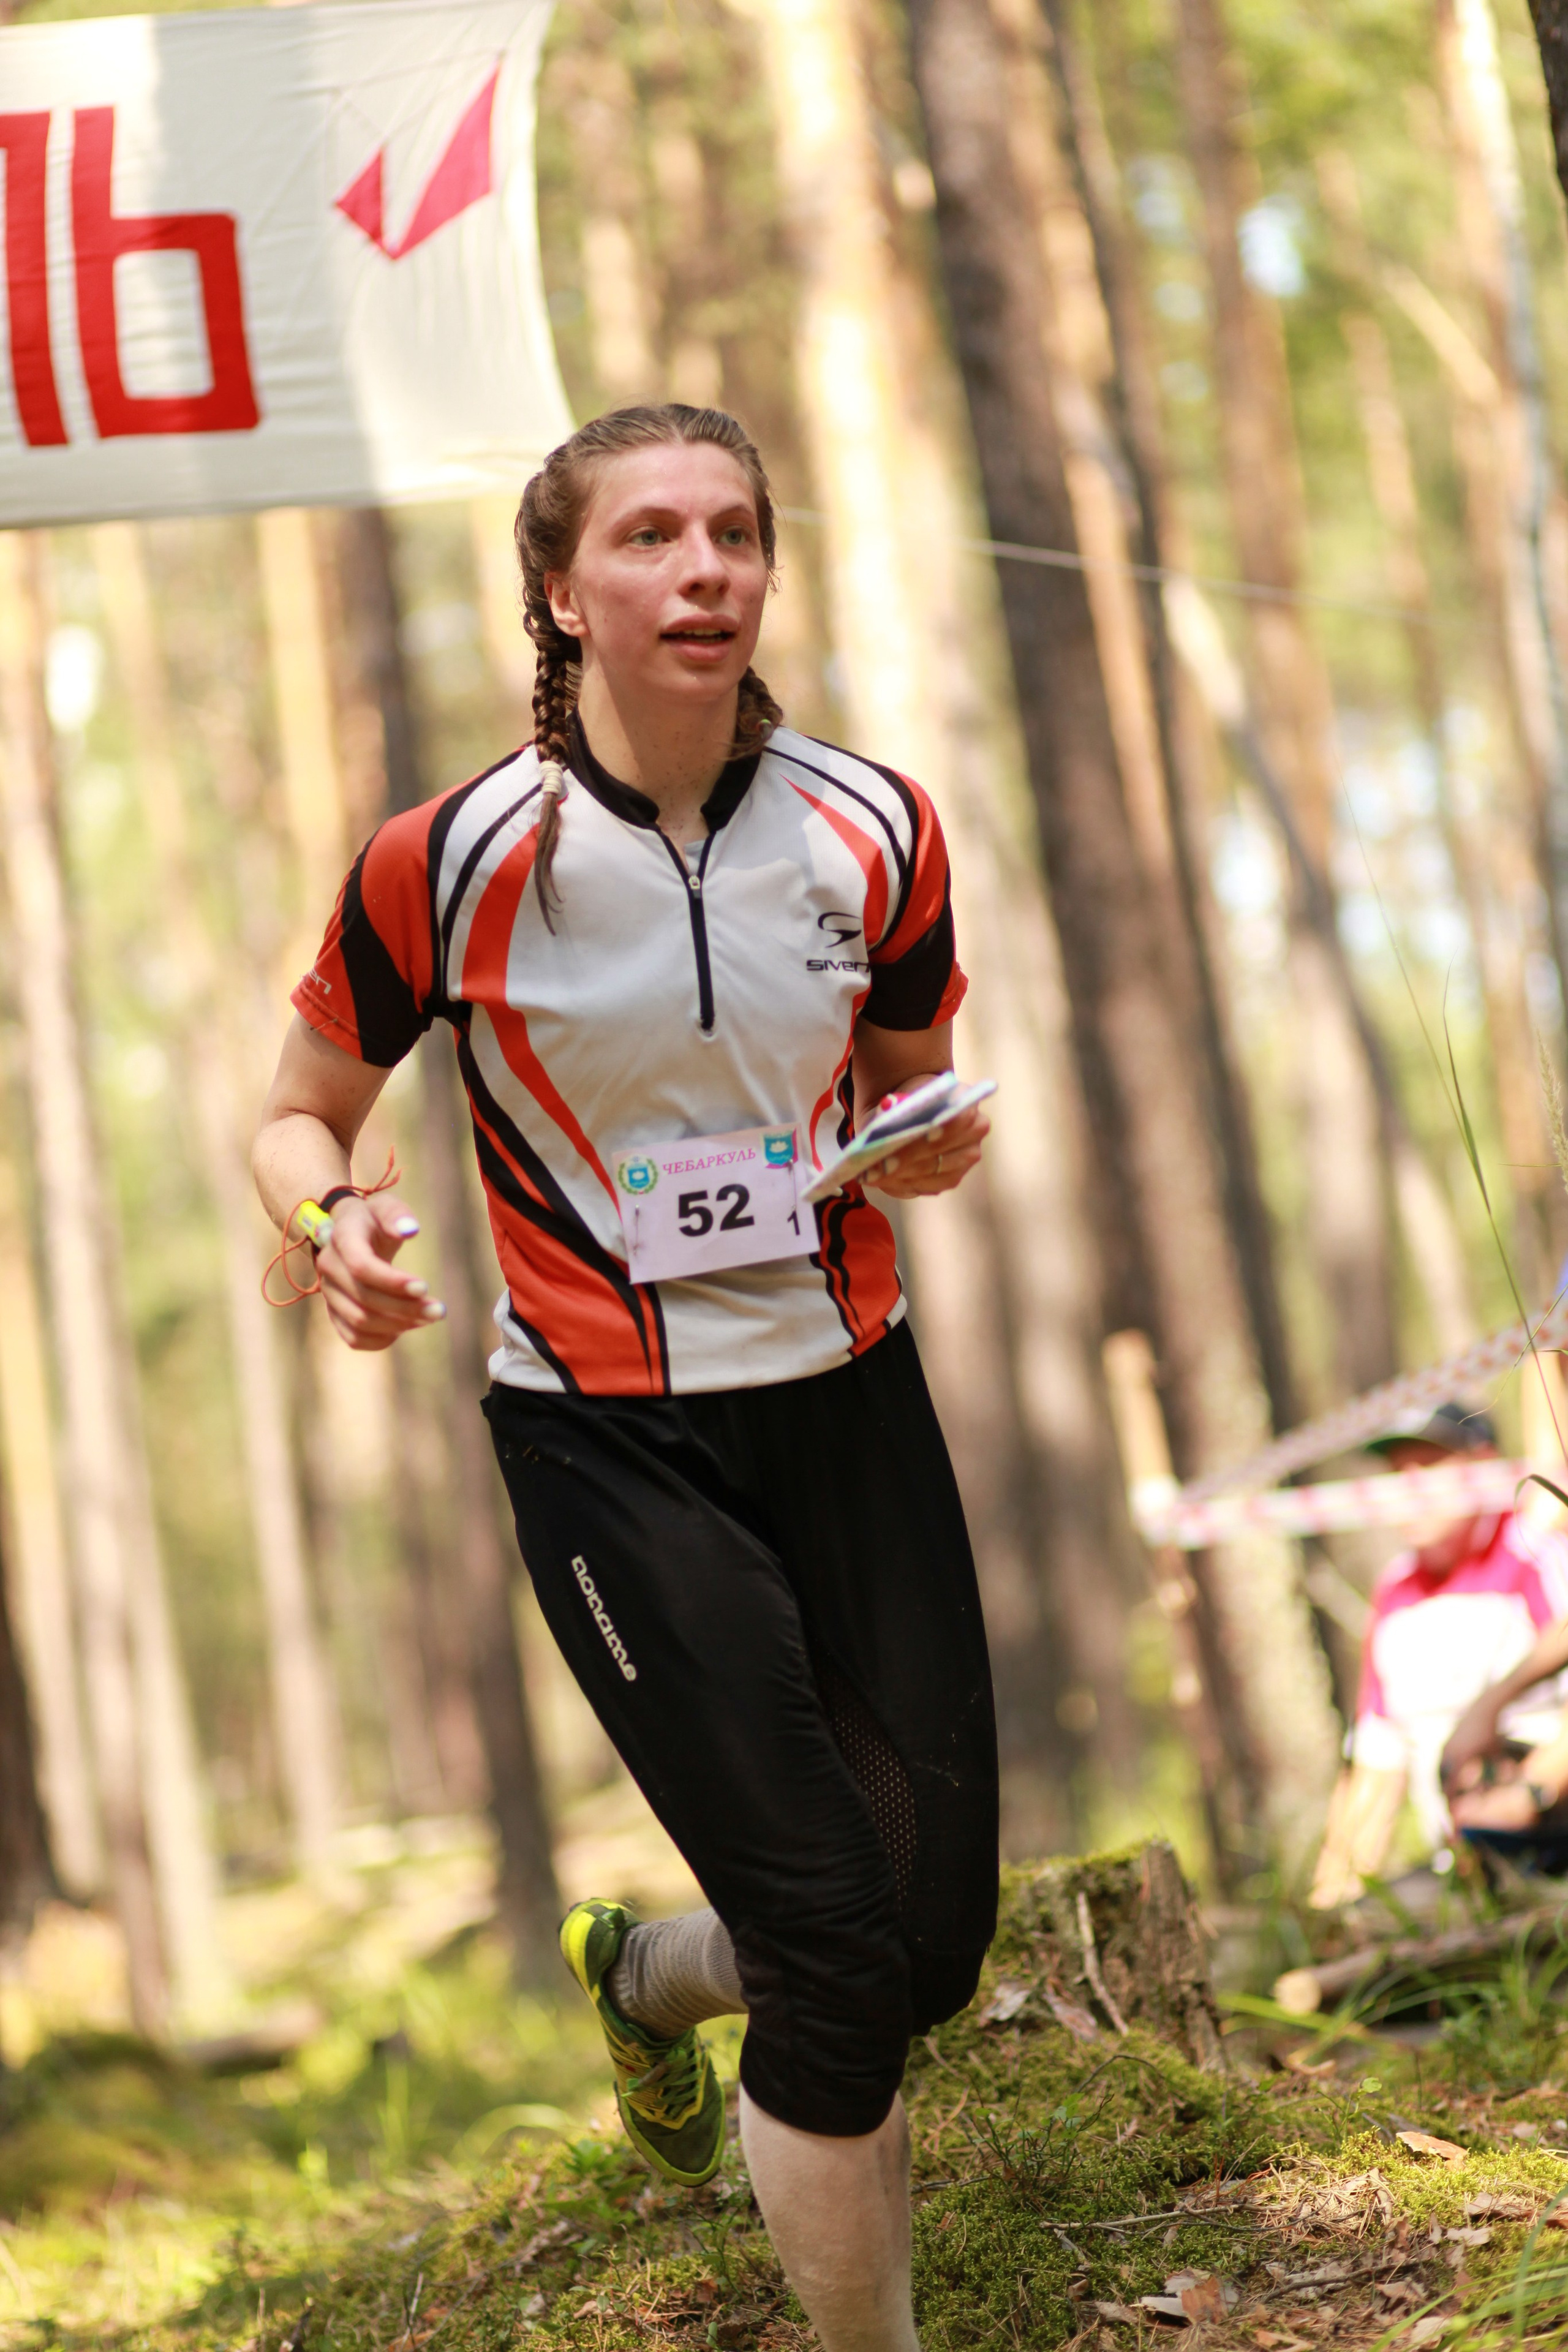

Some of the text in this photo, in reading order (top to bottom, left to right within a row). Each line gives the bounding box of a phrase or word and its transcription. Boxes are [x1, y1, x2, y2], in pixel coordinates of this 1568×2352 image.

[662, 1148, 756, 1175] ЧЕБАРКУЛЬ
[677, 1183, 755, 1237] 52
[786, 1210, 801, 1236] 1
[571, 1555, 637, 1681] noname
